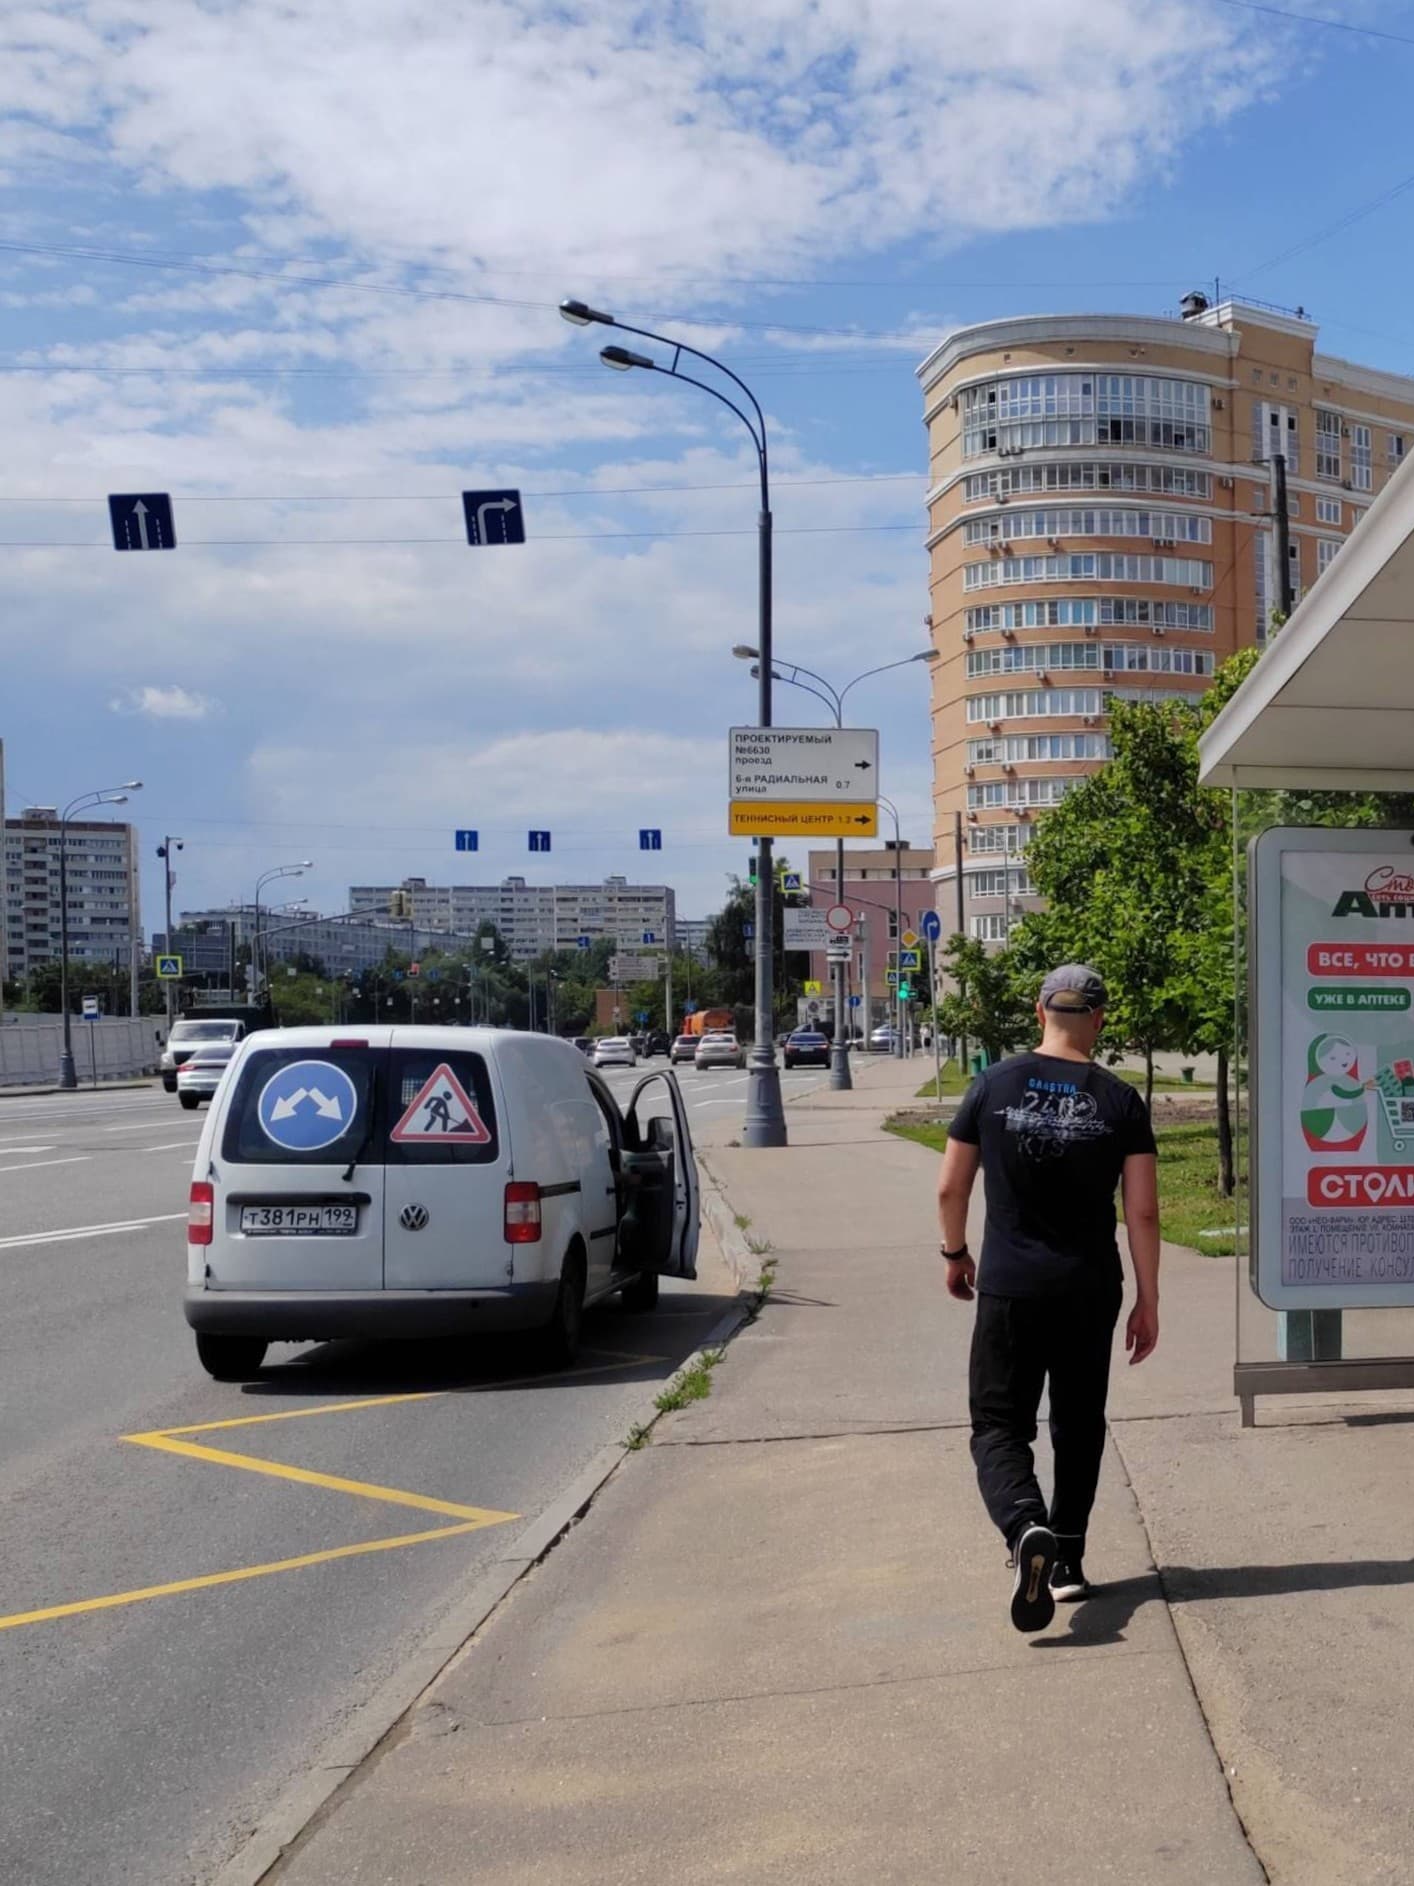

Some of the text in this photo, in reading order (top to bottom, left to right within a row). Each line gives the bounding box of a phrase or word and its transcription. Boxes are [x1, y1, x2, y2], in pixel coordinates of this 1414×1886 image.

[735, 734, 833, 744] ПРОЕКТИРУЕМЫЙ
[735, 757, 773, 766] проезд
[754, 775, 829, 785] РАДИАЛЬНАЯ
[735, 785, 768, 794] улица
[734, 815, 798, 824] ТЕННИСНЫЙ
[801, 816, 834, 825] ЦЕНТР
[1318, 951, 1360, 970] ВСЕ,
[1365, 952, 1404, 969] ЧТО
[1314, 993, 1343, 1005] УЖЕ
[1346, 993, 1355, 1005] В
[1358, 993, 1407, 1006] АПТЕКЕ
[1288, 1233, 1349, 1256] ИМЕЮТСЯ
[1288, 1257, 1363, 1280] ПОЛУЧЕНИЕ
